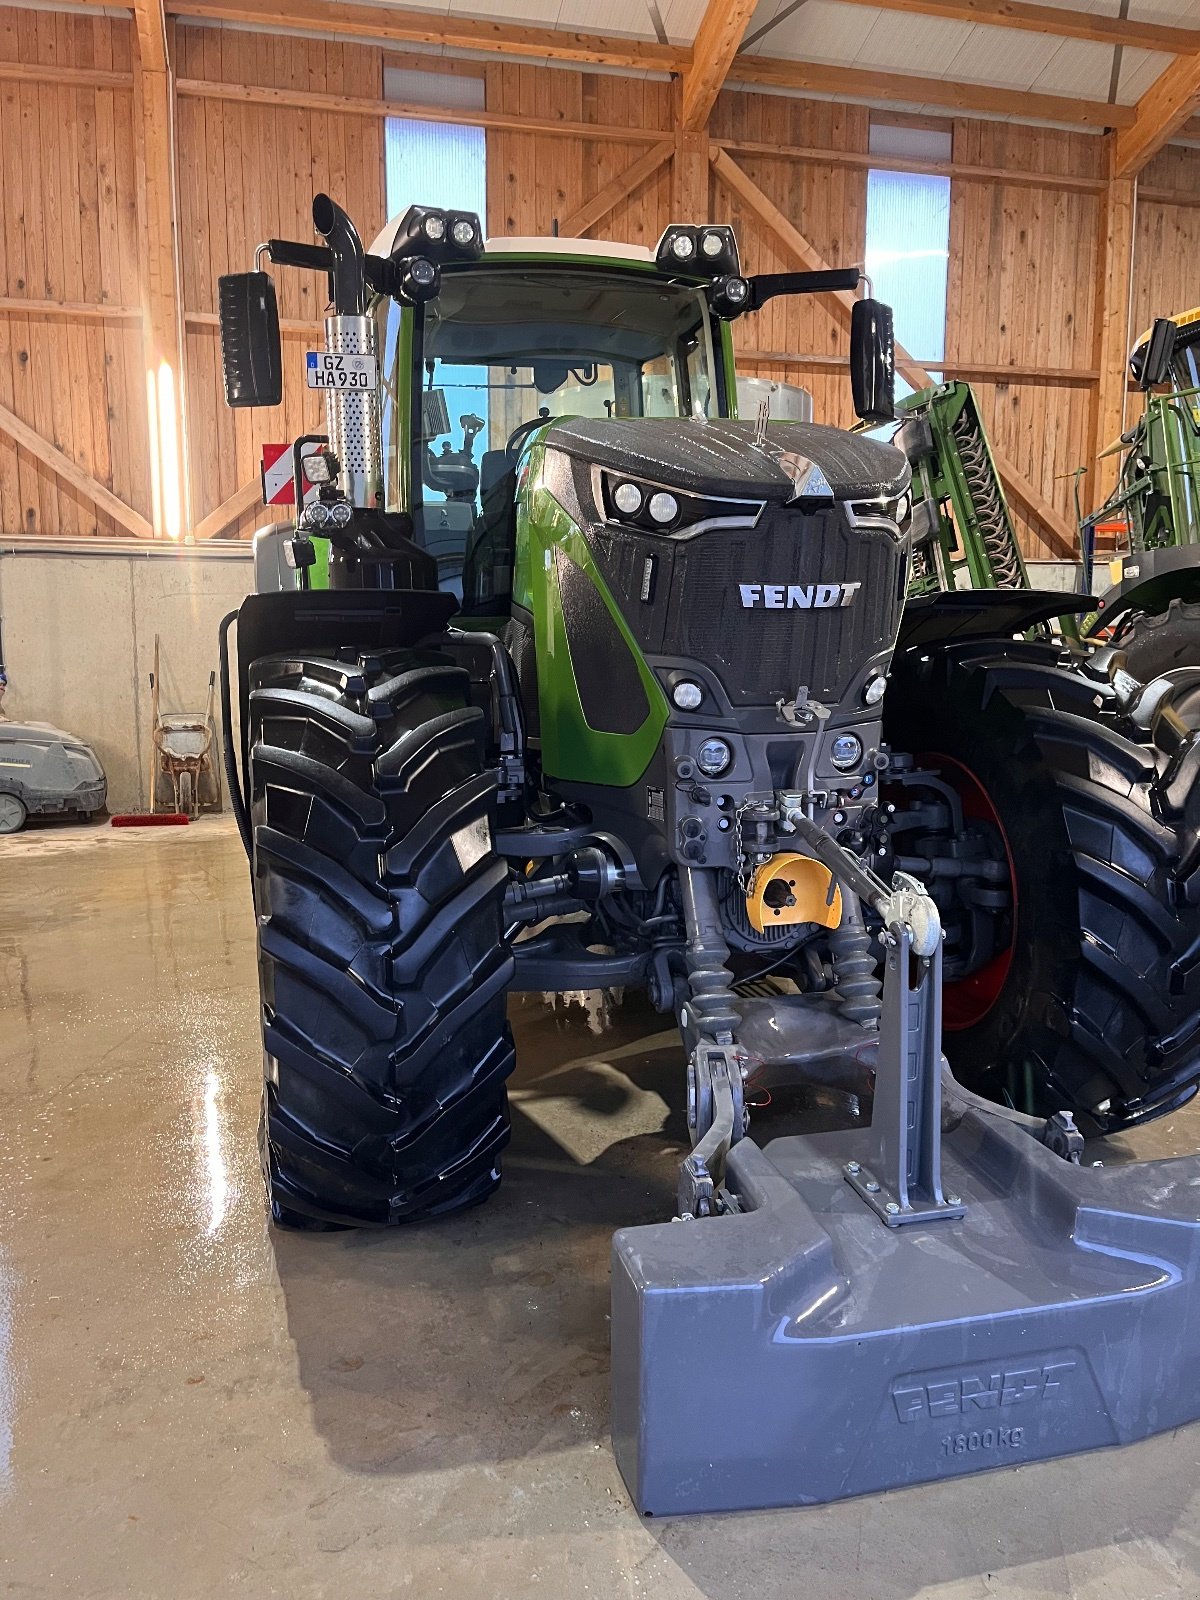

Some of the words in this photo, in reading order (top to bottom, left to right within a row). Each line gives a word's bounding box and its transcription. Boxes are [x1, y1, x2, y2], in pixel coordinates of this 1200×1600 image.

[323, 355, 345, 371] GZ
[739, 582, 862, 609] FENDT
[892, 1362, 1077, 1425] FENDT
[941, 1429, 993, 1457] 1800
[997, 1426, 1025, 1449] kg
